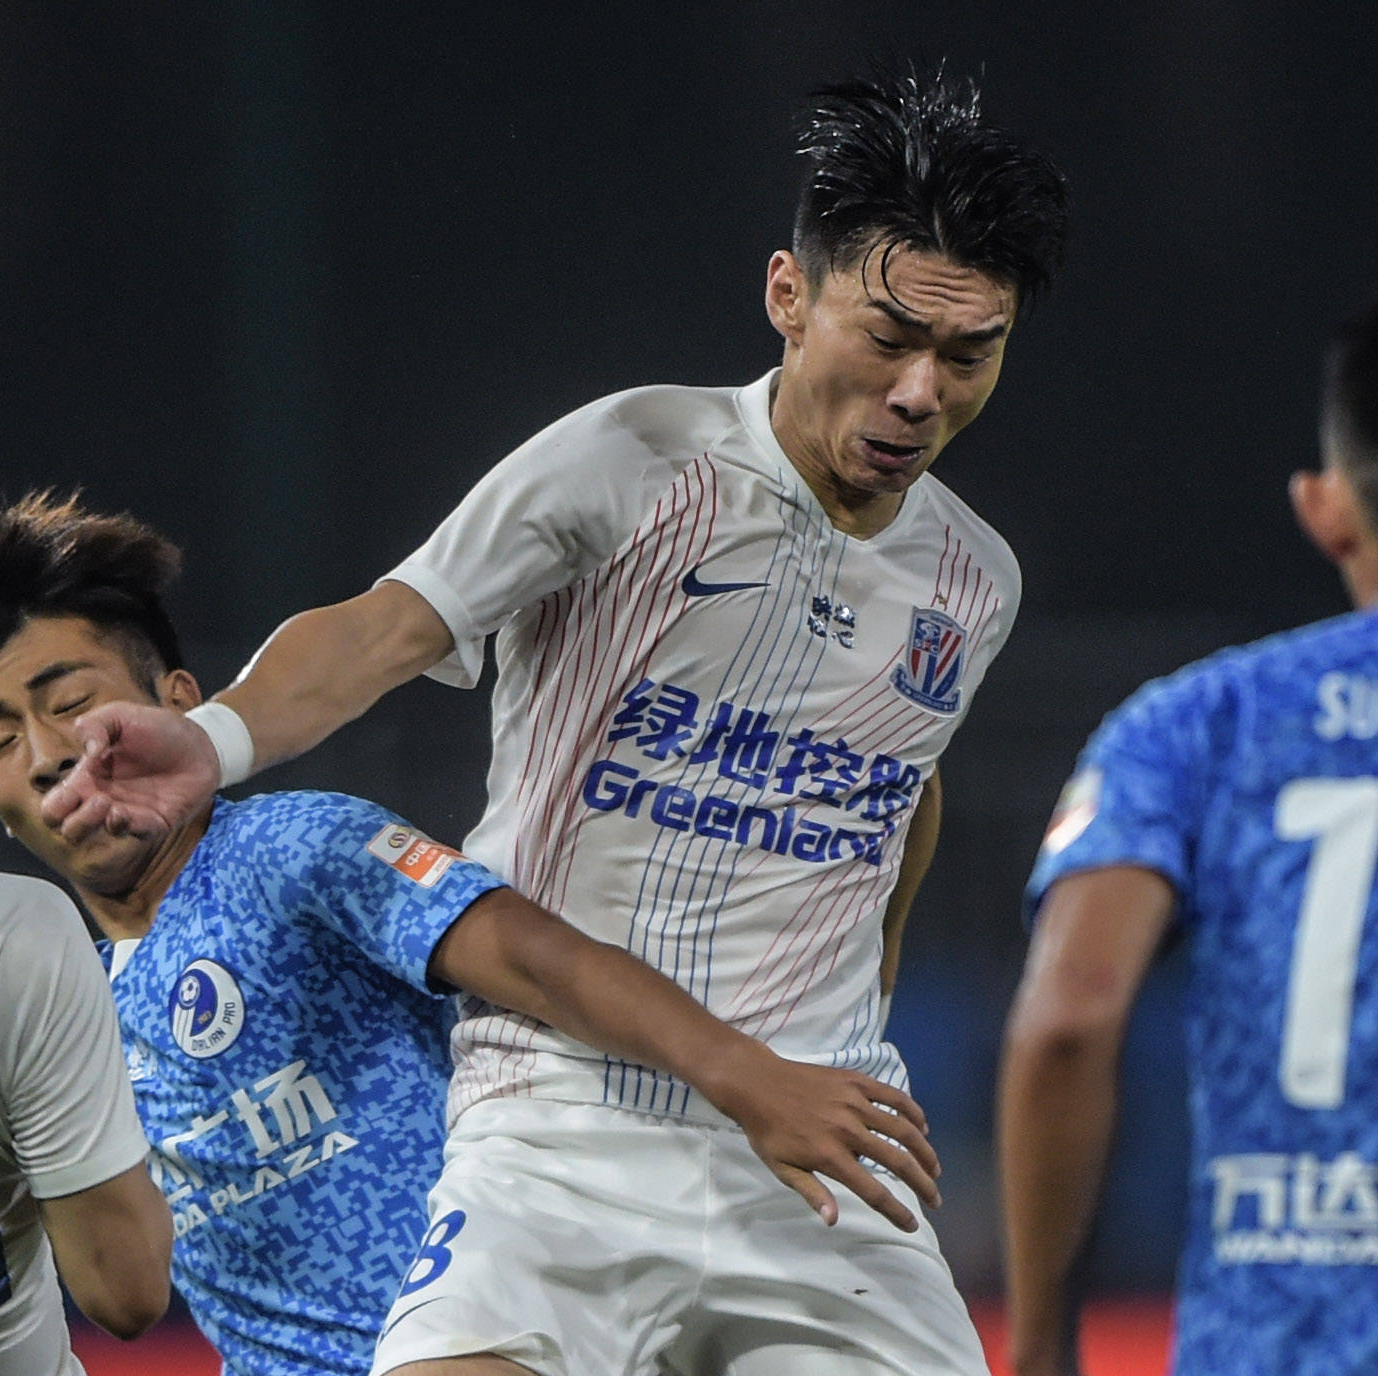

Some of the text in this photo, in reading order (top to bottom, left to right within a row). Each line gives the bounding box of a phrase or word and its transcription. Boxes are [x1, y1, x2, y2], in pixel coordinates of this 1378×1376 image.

[221, 1001, 237, 1026] PRO
[209, 1130, 361, 1215] PLAZA
[399, 1209, 467, 1299] 8
